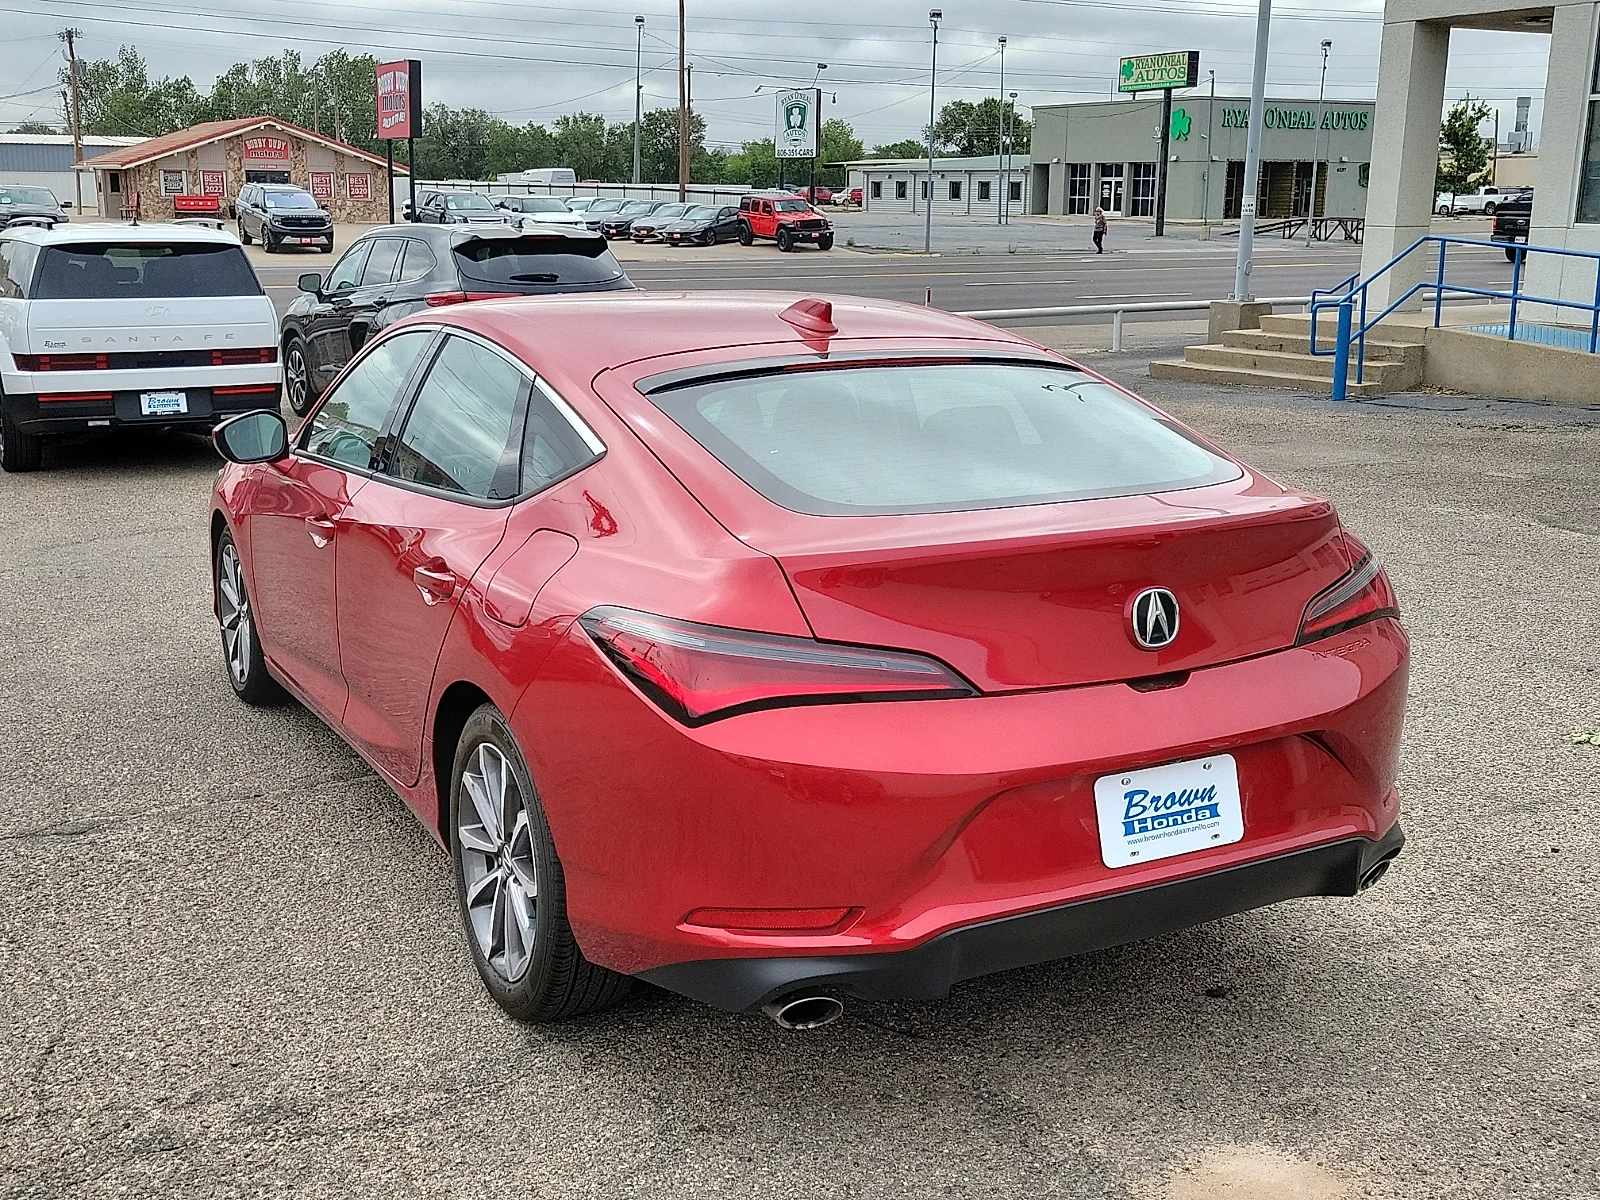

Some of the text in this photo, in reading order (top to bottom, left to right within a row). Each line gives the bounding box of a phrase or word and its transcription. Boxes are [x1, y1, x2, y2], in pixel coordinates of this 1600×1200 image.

[1135, 54, 1187, 70] RYAN O'NEAL
[1134, 67, 1186, 83] AUTOS
[382, 92, 406, 113] motors
[1222, 106, 1369, 130] RYA O'NEAL AUTOS
[786, 130, 806, 139] AUTOS
[245, 137, 287, 150] BOBBY DUBY
[250, 150, 284, 158] motors
[777, 148, 814, 157] 806-351-CARS
[204, 174, 222, 182] BEST
[313, 176, 330, 184] BEST
[205, 185, 224, 193] 2022
[81, 333, 235, 343] SANTA FE
[147, 397, 180, 405] Brown
[1312, 637, 1373, 662] INTEGRA
[1123, 784, 1218, 821] Brown
[1133, 808, 1211, 834] Honda
[1126, 821, 1220, 845] www.brownhondaamarillo.com
